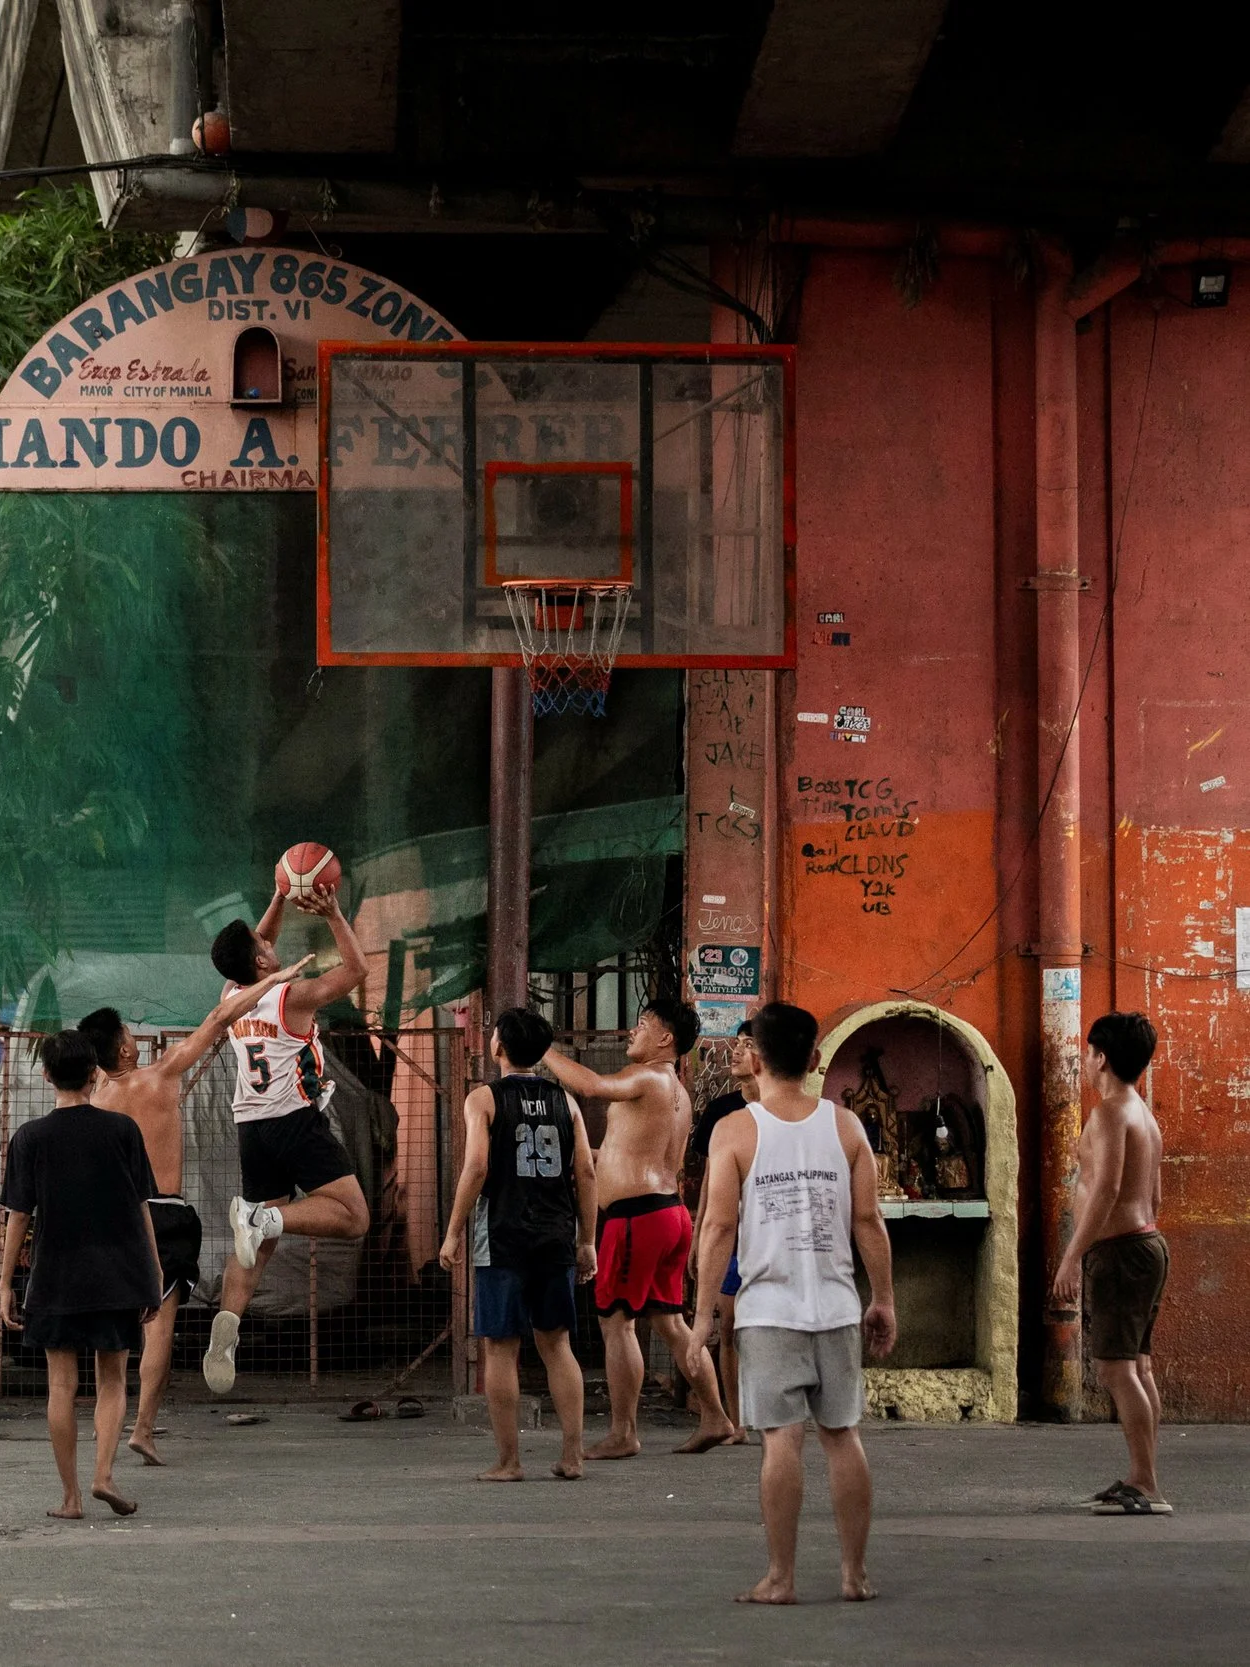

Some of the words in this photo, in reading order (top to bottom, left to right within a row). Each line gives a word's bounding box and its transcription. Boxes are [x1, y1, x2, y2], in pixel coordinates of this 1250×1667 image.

[20, 252, 265, 399] BARANGAY
[271, 254, 350, 305] 865
[209, 300, 276, 321] DIST.
[285, 300, 311, 321] VI
[127, 357, 211, 382] Estrada
[80, 386, 113, 398] MAYOR
[124, 386, 151, 398] CITY
[154, 386, 167, 398] OF
[170, 386, 212, 398] MANILA
[230, 417, 299, 469] A.
[180, 469, 316, 487] CHAIRMA
[245, 1042, 272, 1095] 5
[515, 1123, 562, 1177] 29
